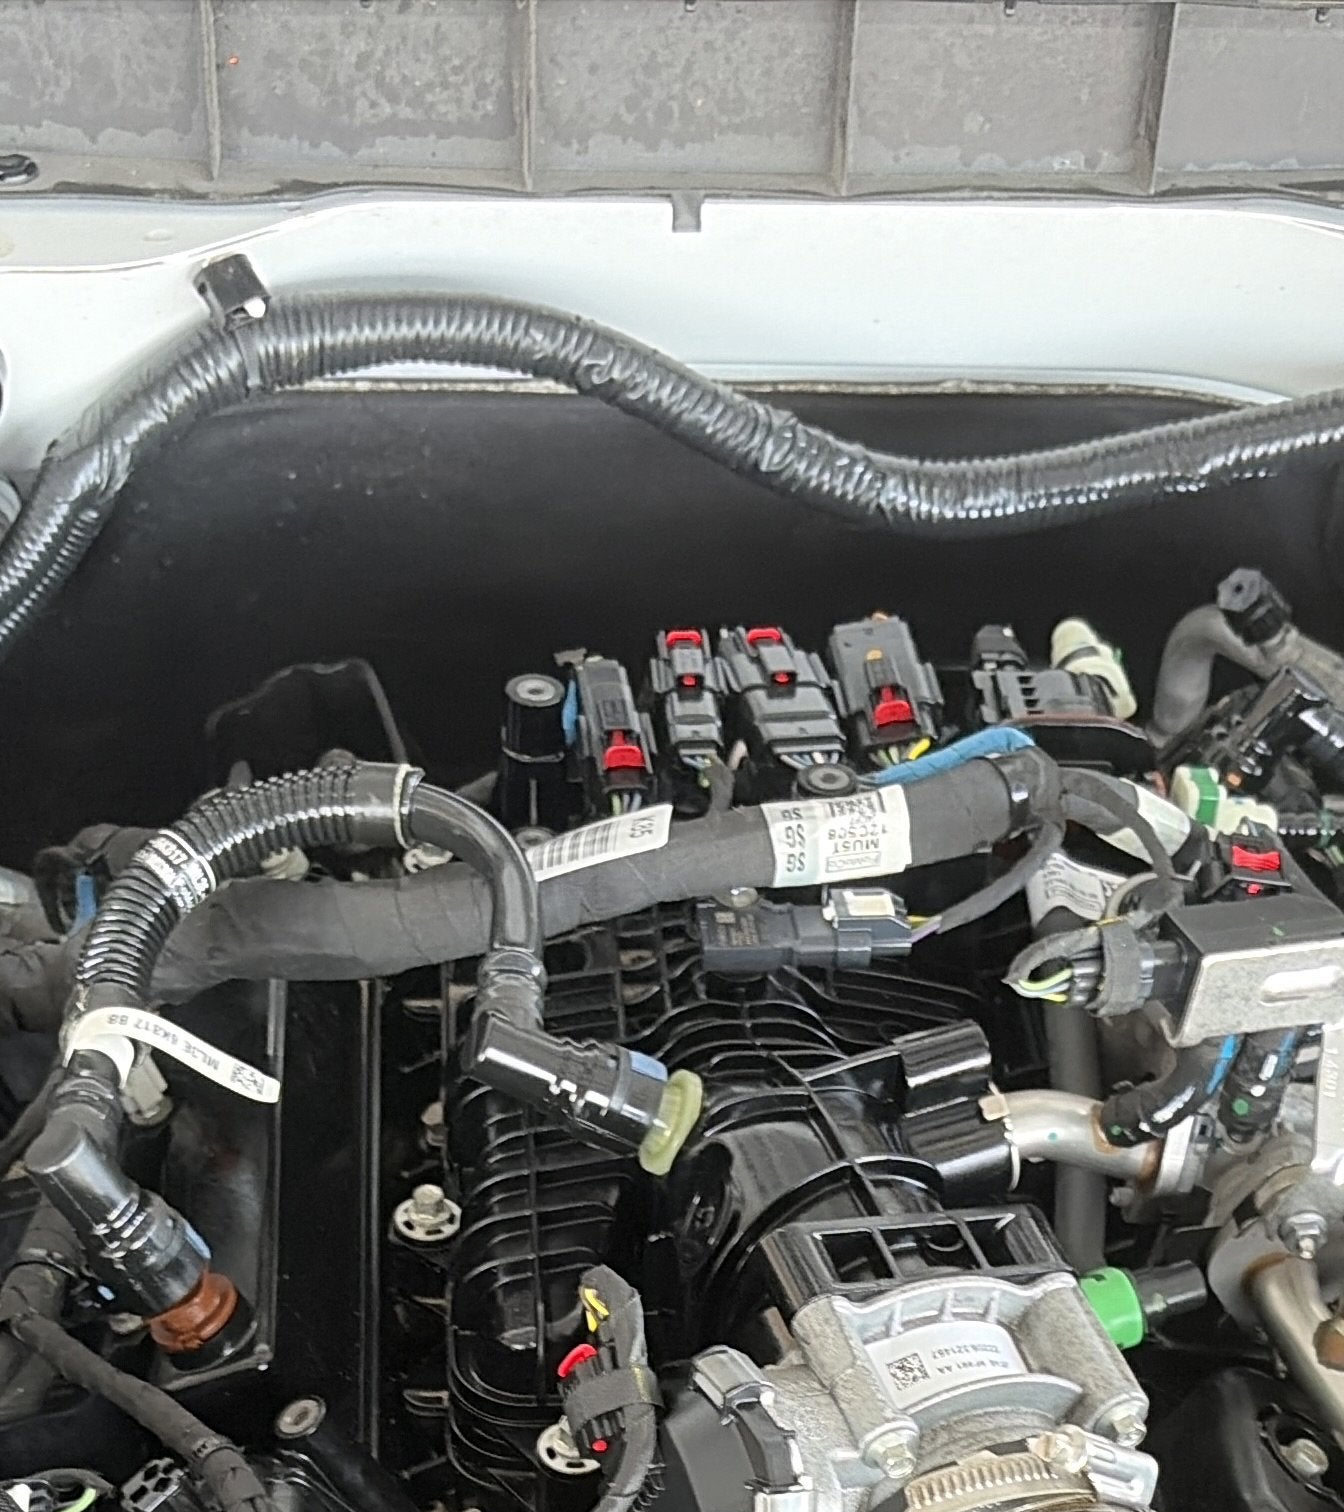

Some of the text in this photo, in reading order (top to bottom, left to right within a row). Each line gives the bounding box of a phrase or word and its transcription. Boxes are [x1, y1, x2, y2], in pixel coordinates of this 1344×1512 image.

[784, 823, 805, 848] SG
[831, 837, 880, 854] MUST
[785, 852, 806, 873] SG
